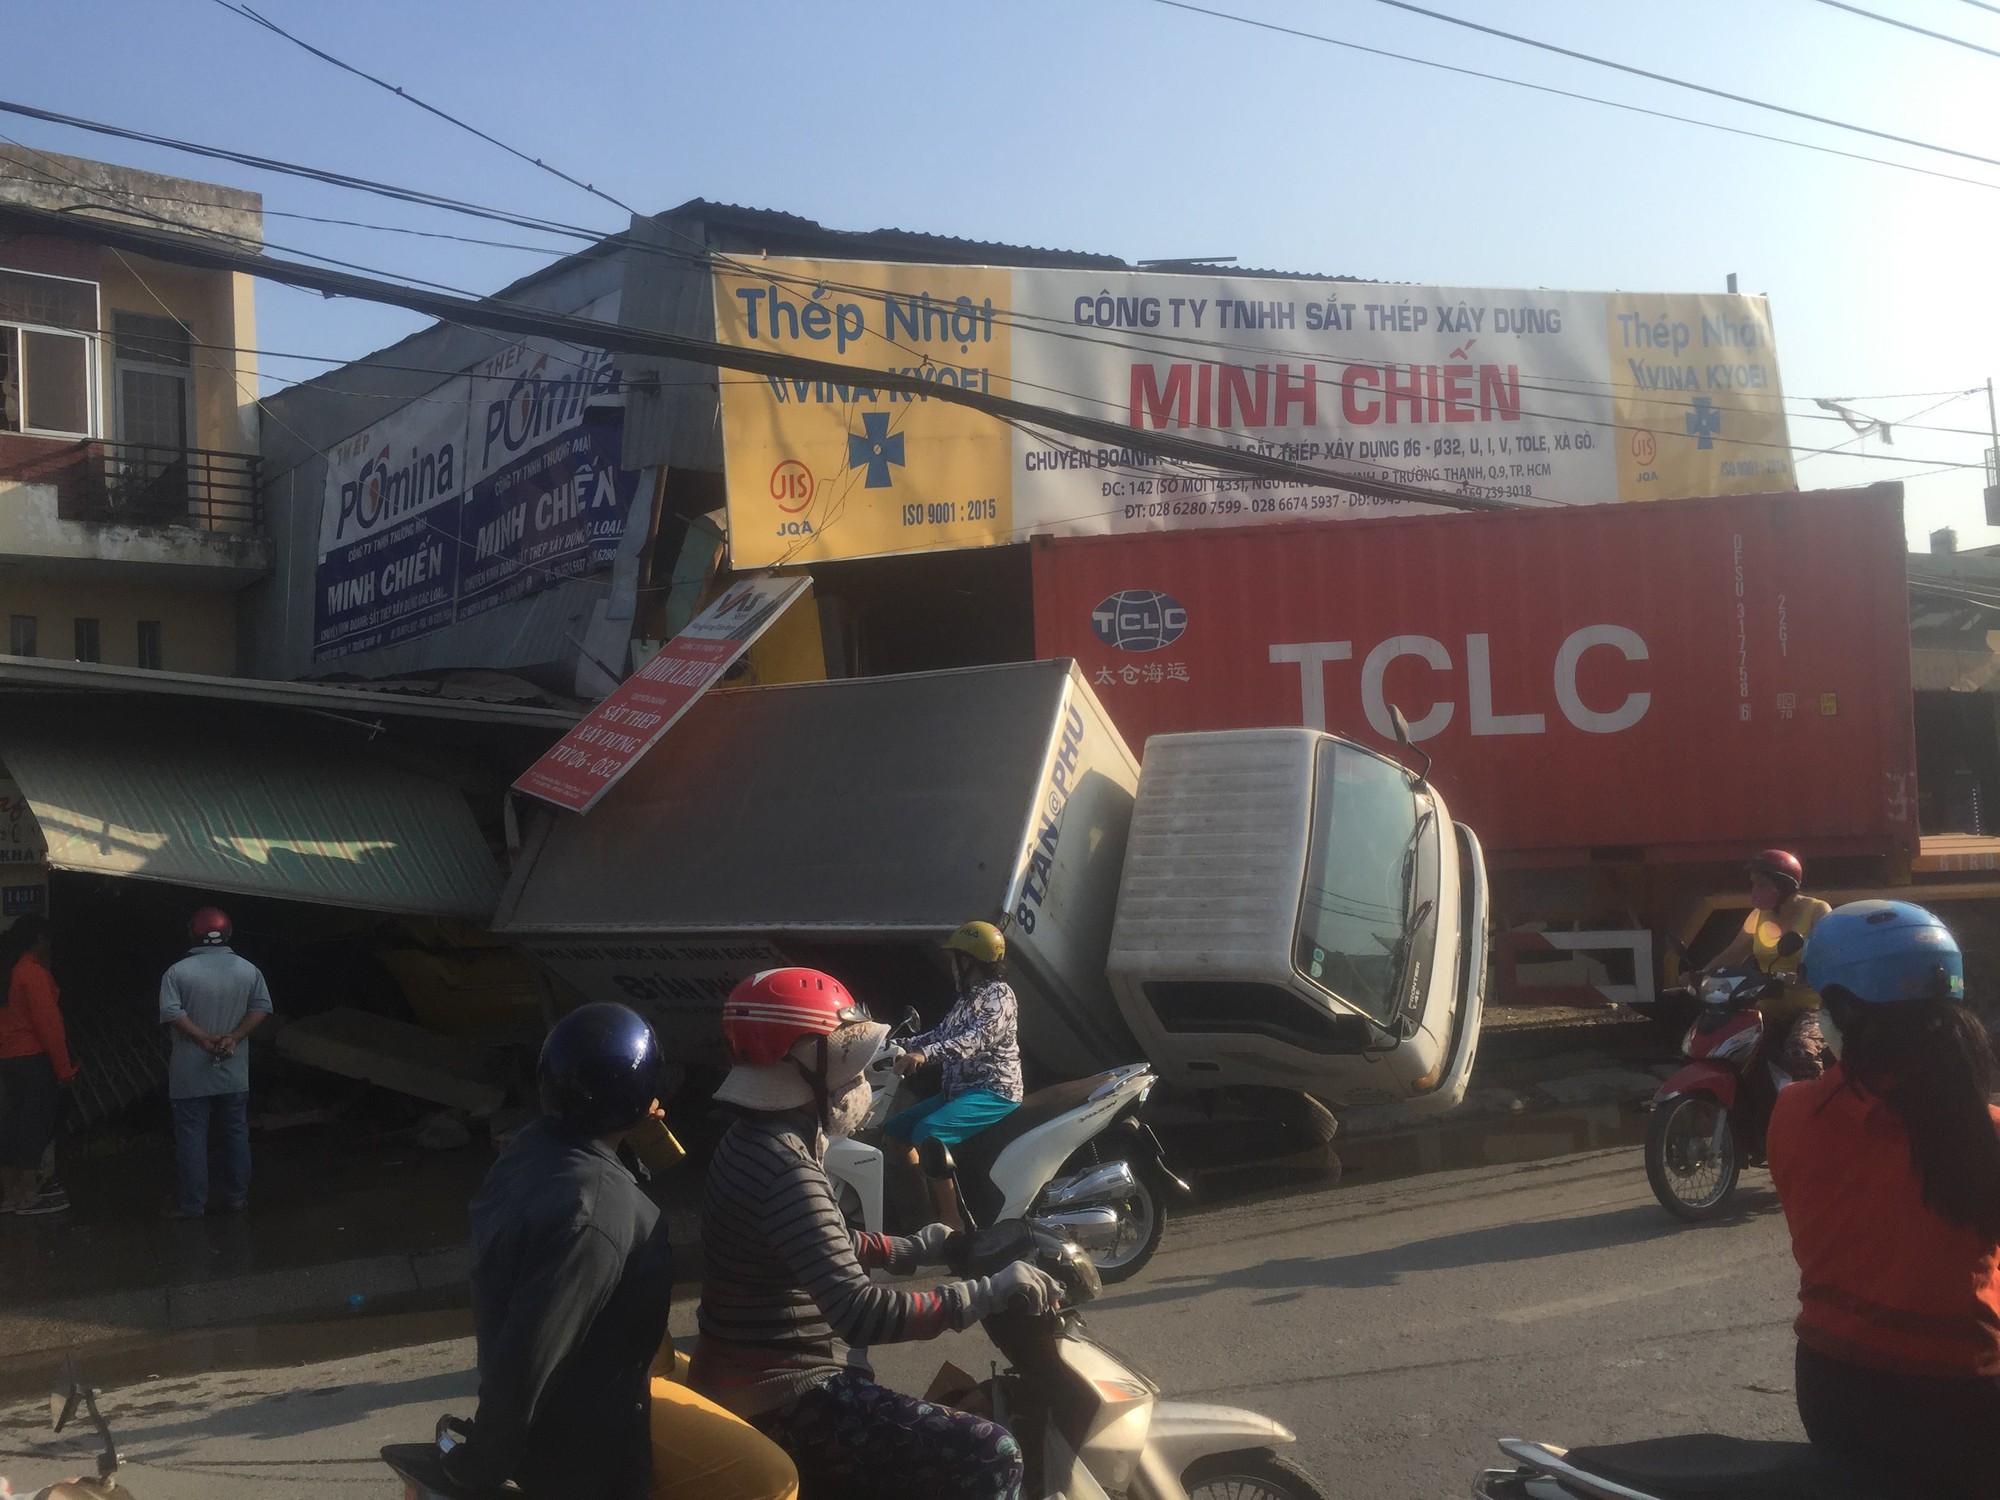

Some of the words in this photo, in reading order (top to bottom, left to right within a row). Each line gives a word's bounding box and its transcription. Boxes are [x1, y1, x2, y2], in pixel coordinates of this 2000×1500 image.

[735, 284, 864, 354] Thép
[885, 291, 996, 354] Nhật
[1073, 289, 1161, 328] CÔNG
[1168, 298, 1208, 329] TY
[1215, 299, 1295, 330] TNHH
[1305, 293, 1357, 331] SẮT
[1364, 298, 1428, 333] THÉP
[1436, 301, 1485, 333] XÂY
[1494, 306, 1562, 339] DỰNG
[1617, 312, 1690, 357] Thép
[1129, 363, 1317, 429] MINH
[1341, 338, 1521, 426] CHIẾN
[1324, 438, 1354, 460] XÂY
[1528, 463, 1551, 477] HCM
[1636, 470, 1658, 483] JQA
[770, 472, 808, 500] JIS
[1129, 480, 1153, 496] 142
[475, 502, 527, 563] MINH
[534, 454, 617, 532] CHIẾN
[902, 503, 925, 526] ISO
[927, 502, 957, 524] 9001
[966, 498, 997, 520] 2015
[1149, 502, 1170, 517] 028
[1172, 501, 1207, 516] 6280
[1210, 499, 1241, 515] 7599
[1252, 498, 1276, 512] 028
[1278, 497, 1308, 511] 6674
[1311, 494, 1340, 509] 5937
[776, 519, 814, 537] JQA
[327, 570, 376, 616] MINH
[380, 534, 444, 597] CHIẾN
[1091, 608, 1187, 633] TCLC
[1093, 662, 1191, 686] 太仓海运
[1269, 624, 1651, 742] TCLC
[622, 710, 662, 729] THÉP
[574, 724, 608, 743] XÂY
[1408, 961, 1421, 1010] FRONTIER
[854, 1157, 878, 1166] HONDA
